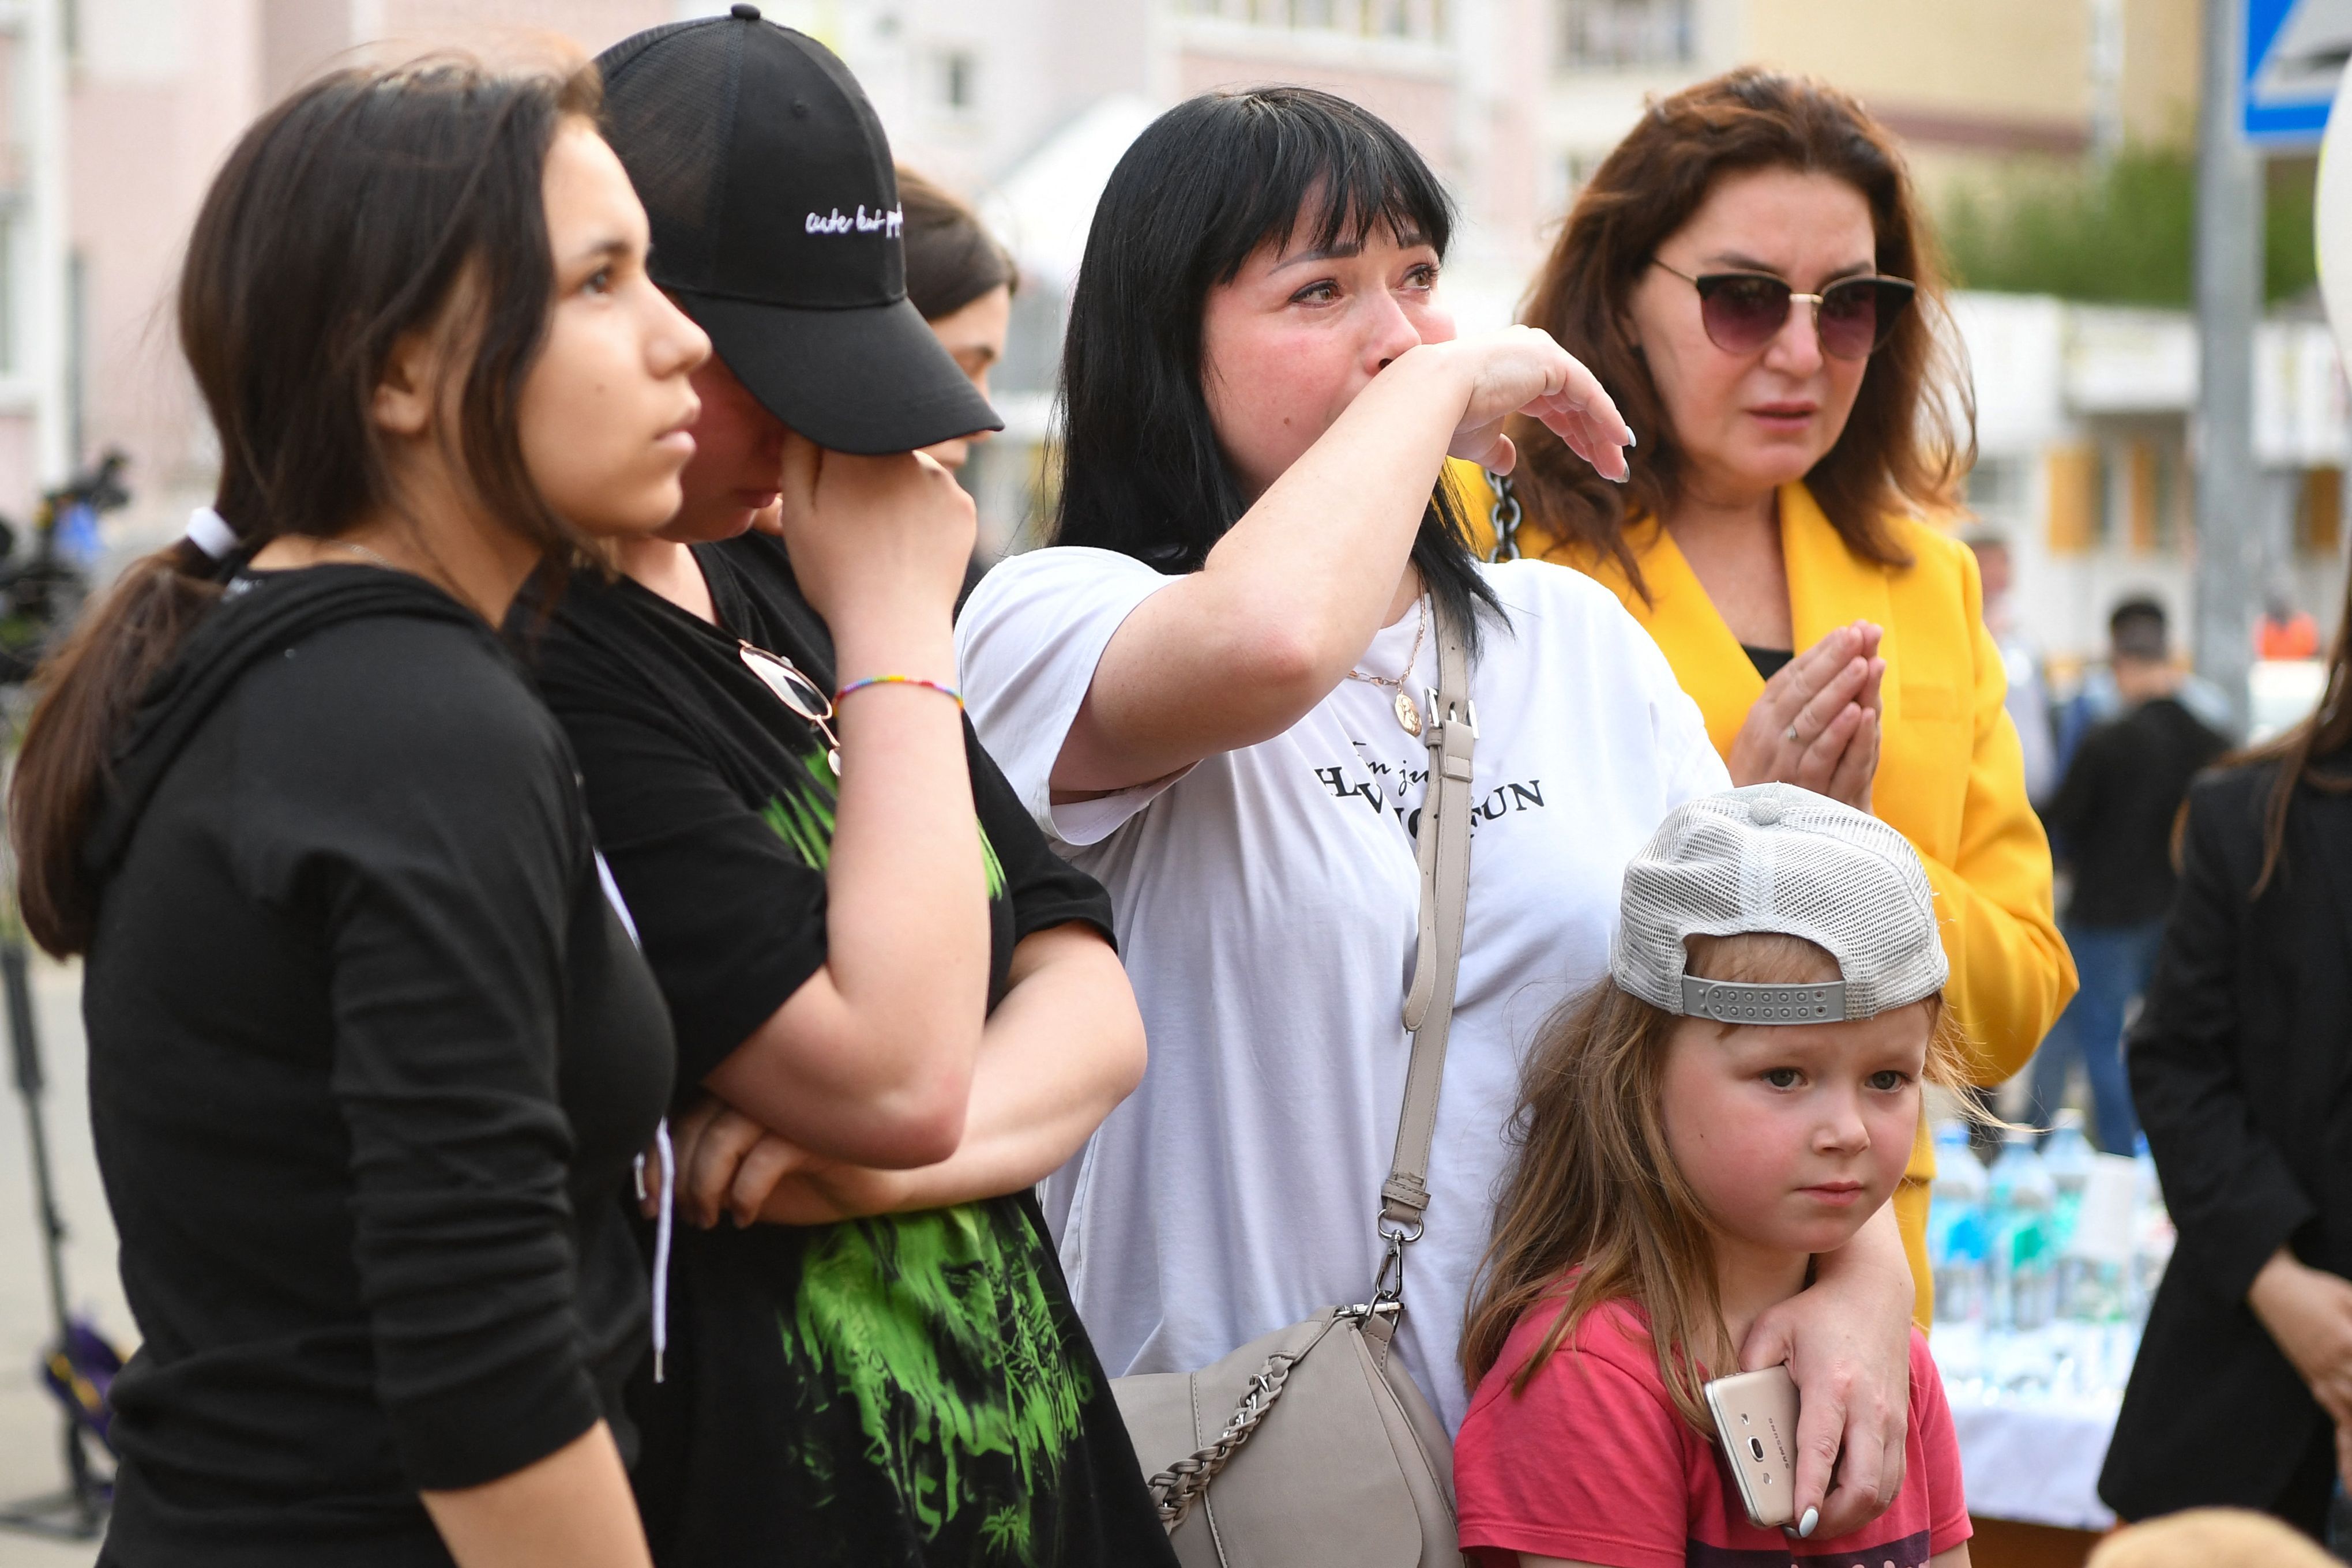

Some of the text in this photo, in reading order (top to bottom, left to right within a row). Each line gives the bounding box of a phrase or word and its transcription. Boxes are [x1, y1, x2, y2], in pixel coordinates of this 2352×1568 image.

[805, 208, 854, 234] cute
[856, 204, 886, 232] but
[1768, 1417, 1790, 1470] SAMSUNG
